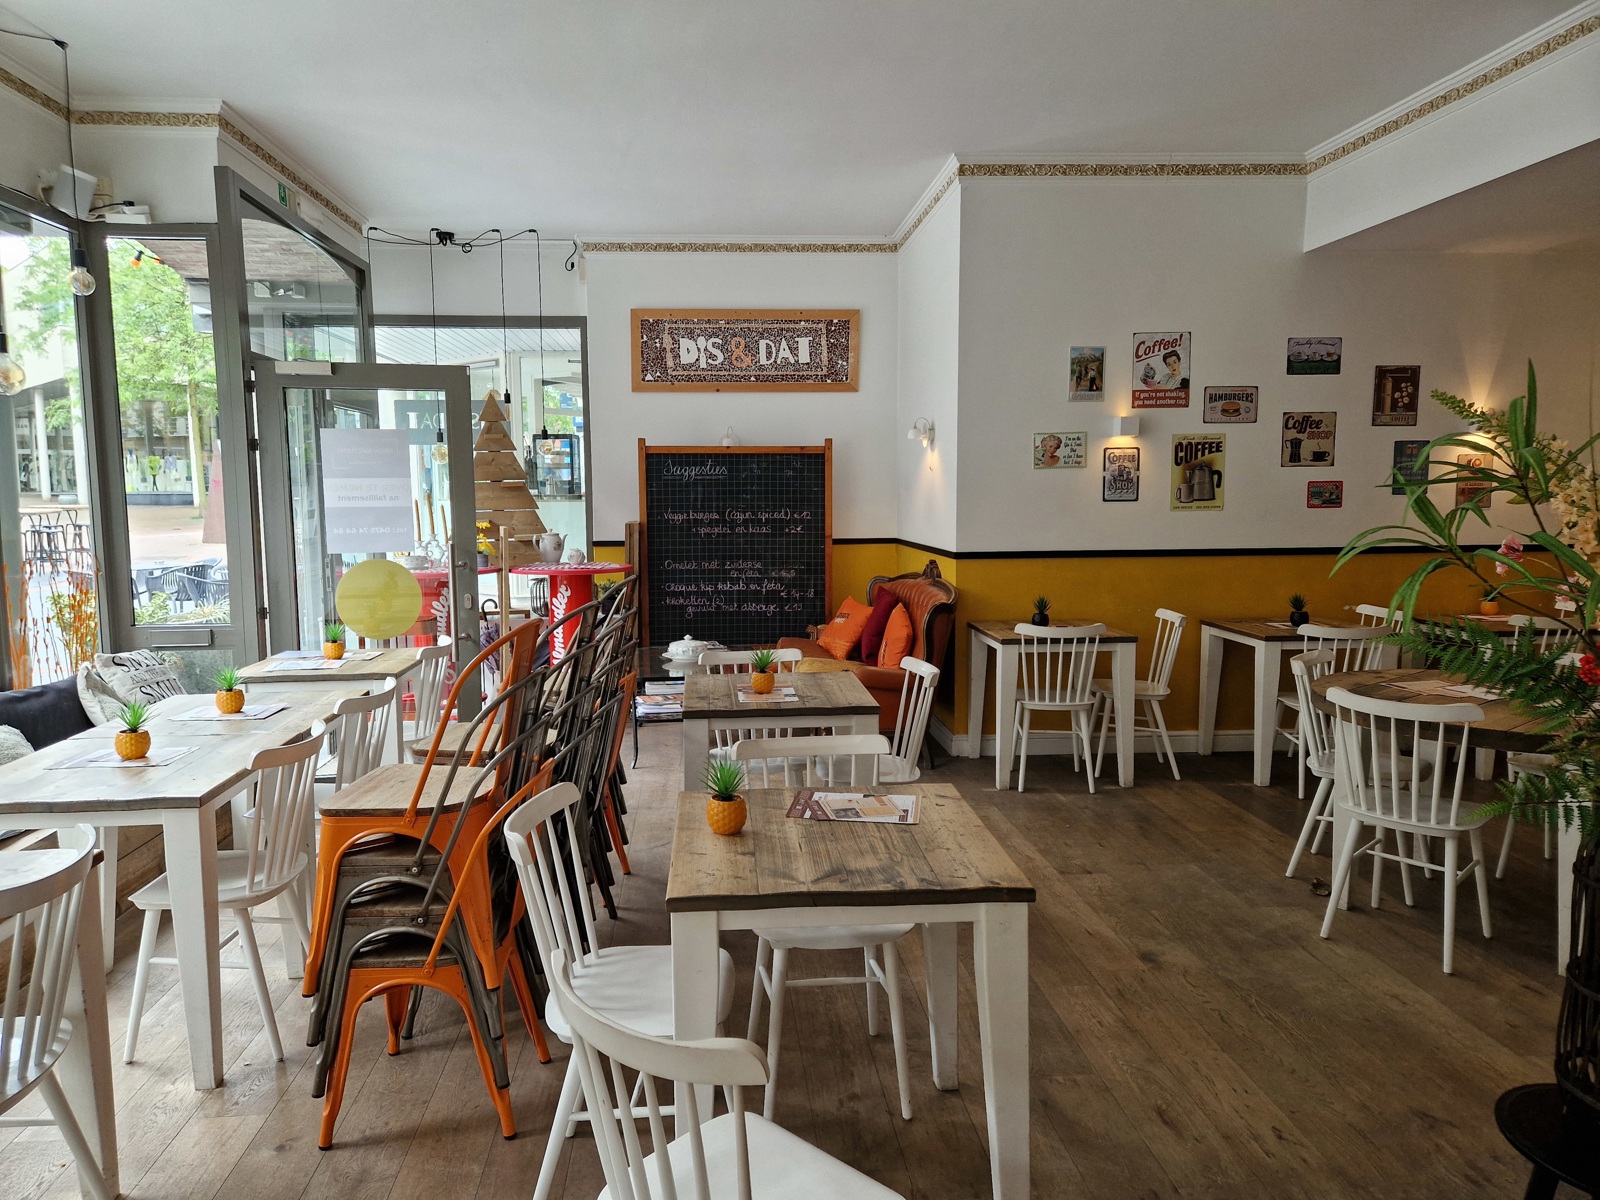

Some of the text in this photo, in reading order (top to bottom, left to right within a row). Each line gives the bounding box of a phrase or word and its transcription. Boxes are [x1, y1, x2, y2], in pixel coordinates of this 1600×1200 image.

[731, 337, 752, 368] &
[759, 336, 813, 365] DAT
[1135, 333, 1184, 360] Coffee!
[1208, 392, 1254, 404] HAMBURGERS
[1284, 415, 1323, 434] Coffee
[1307, 430, 1333, 440] SHOP
[1174, 441, 1223, 467] COFFEE
[111, 651, 164, 673] SMIL
